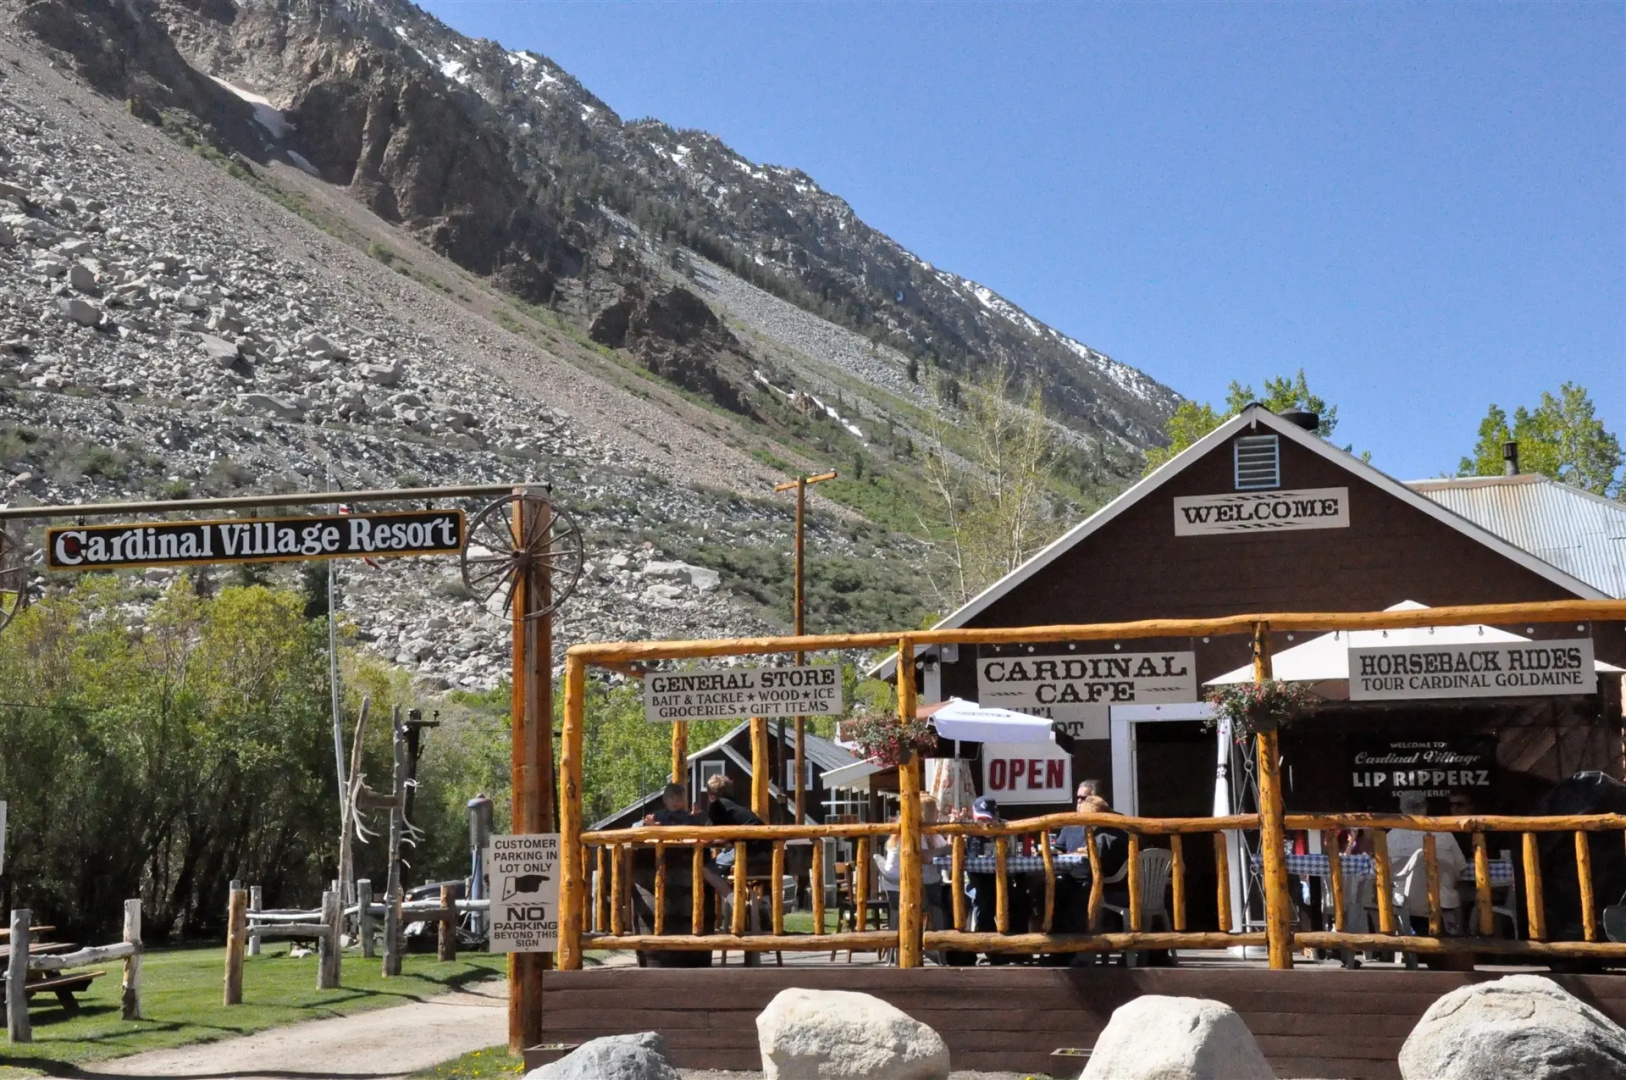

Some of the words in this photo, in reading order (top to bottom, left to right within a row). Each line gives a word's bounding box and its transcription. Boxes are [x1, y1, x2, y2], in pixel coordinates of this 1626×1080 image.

[1181, 498, 1339, 524] WELCOME
[55, 524, 212, 566] Cardinal
[219, 521, 340, 556] Village
[348, 516, 457, 551] Resort
[984, 656, 1187, 683] CARDINAL
[1360, 650, 1502, 676] HORSEBACK
[1508, 648, 1582, 671] RIDES
[651, 673, 754, 693] GENERAL
[760, 669, 835, 688] STORE
[1361, 676, 1404, 692] TOUR
[1409, 674, 1491, 690] CARDINAL
[1495, 671, 1583, 687] GOLDMINE
[652, 695, 681, 706] BAIT
[684, 694, 693, 705] &
[698, 692, 744, 704] TACKLE
[758, 689, 799, 701] WOOD
[814, 688, 835, 699] ICE
[1035, 681, 1135, 704] CAFE
[659, 705, 737, 718] GROCERIES
[750, 702, 781, 714] GIFT
[785, 700, 829, 712] ITEMS
[1355, 751, 1420, 764] Cardinal
[989, 758, 1065, 791] OPEN
[1352, 771, 1387, 787] LIP
[1392, 770, 1490, 787] RIPPERZ
[495, 839, 556, 850] CUSTOMER
[494, 851, 542, 861] PARKING
[546, 851, 557, 860] IN
[500, 863, 520, 873] LOT
[523, 863, 552, 873] ONLY
[507, 907, 545, 921] NO
[494, 921, 558, 931] PARKING
[494, 931, 533, 940] BEYOND
[536, 930, 558, 939] THIS
[515, 939, 539, 948] SIGN
